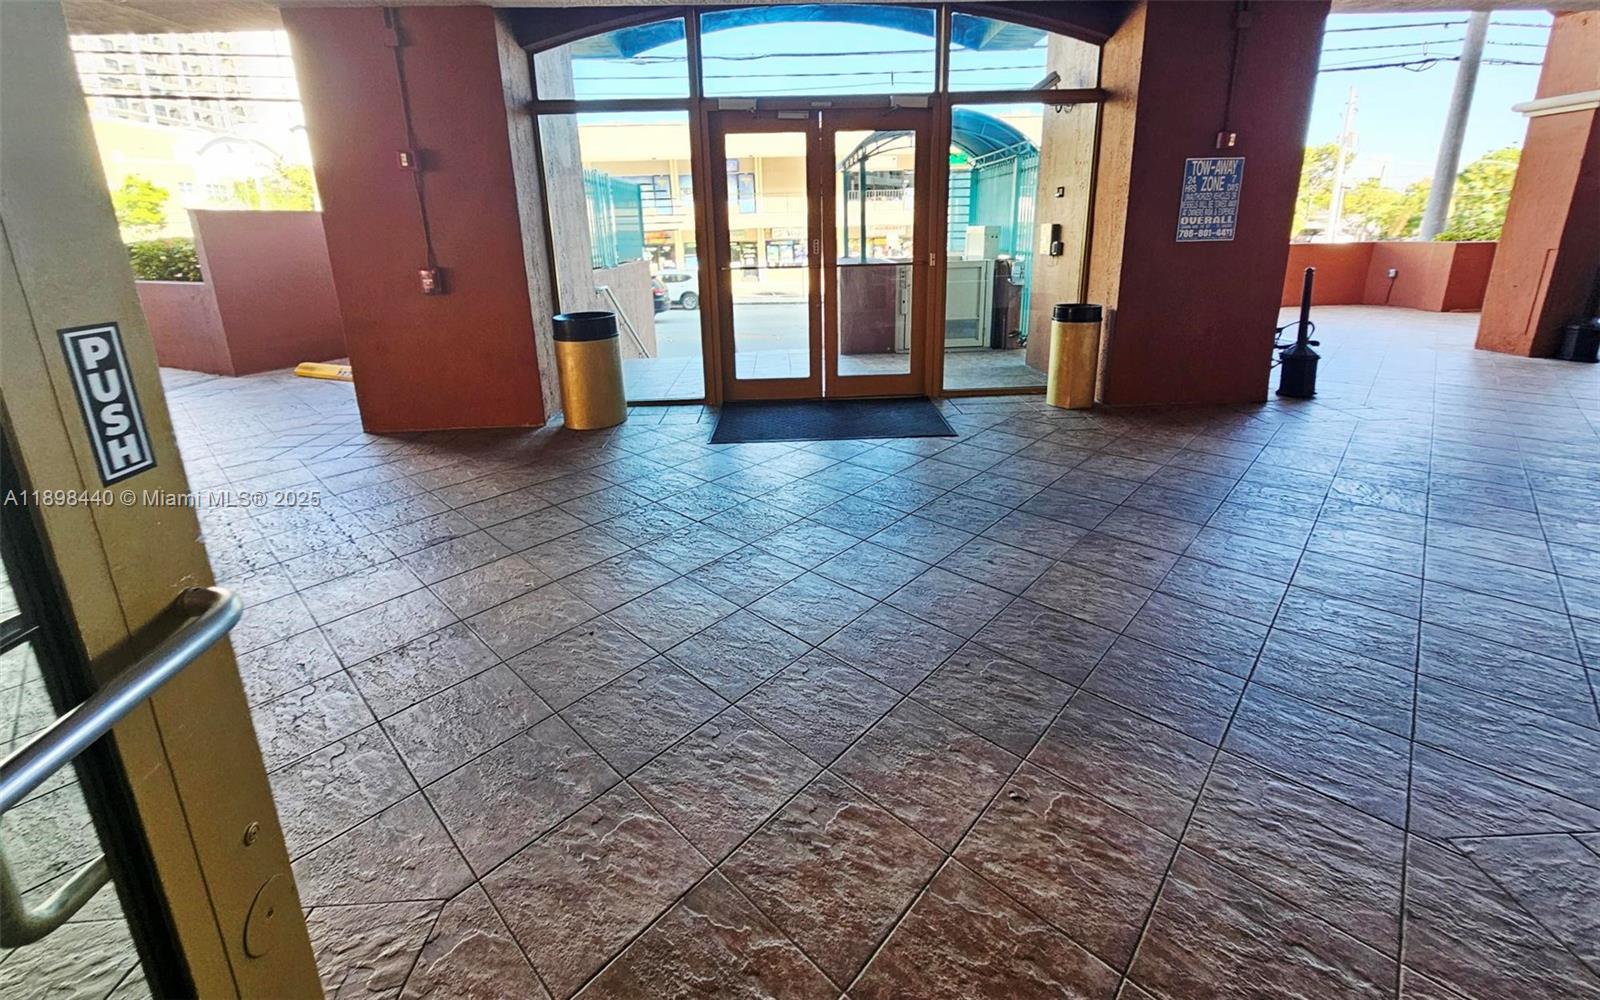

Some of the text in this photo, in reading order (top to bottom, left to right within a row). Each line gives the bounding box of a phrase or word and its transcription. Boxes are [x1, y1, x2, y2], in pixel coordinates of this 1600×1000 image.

[1192, 160, 1239, 175] TOW-AWAY
[1201, 176, 1226, 191] ZONE
[1181, 216, 1233, 224] OVERALL
[78, 336, 143, 471] PUSH
